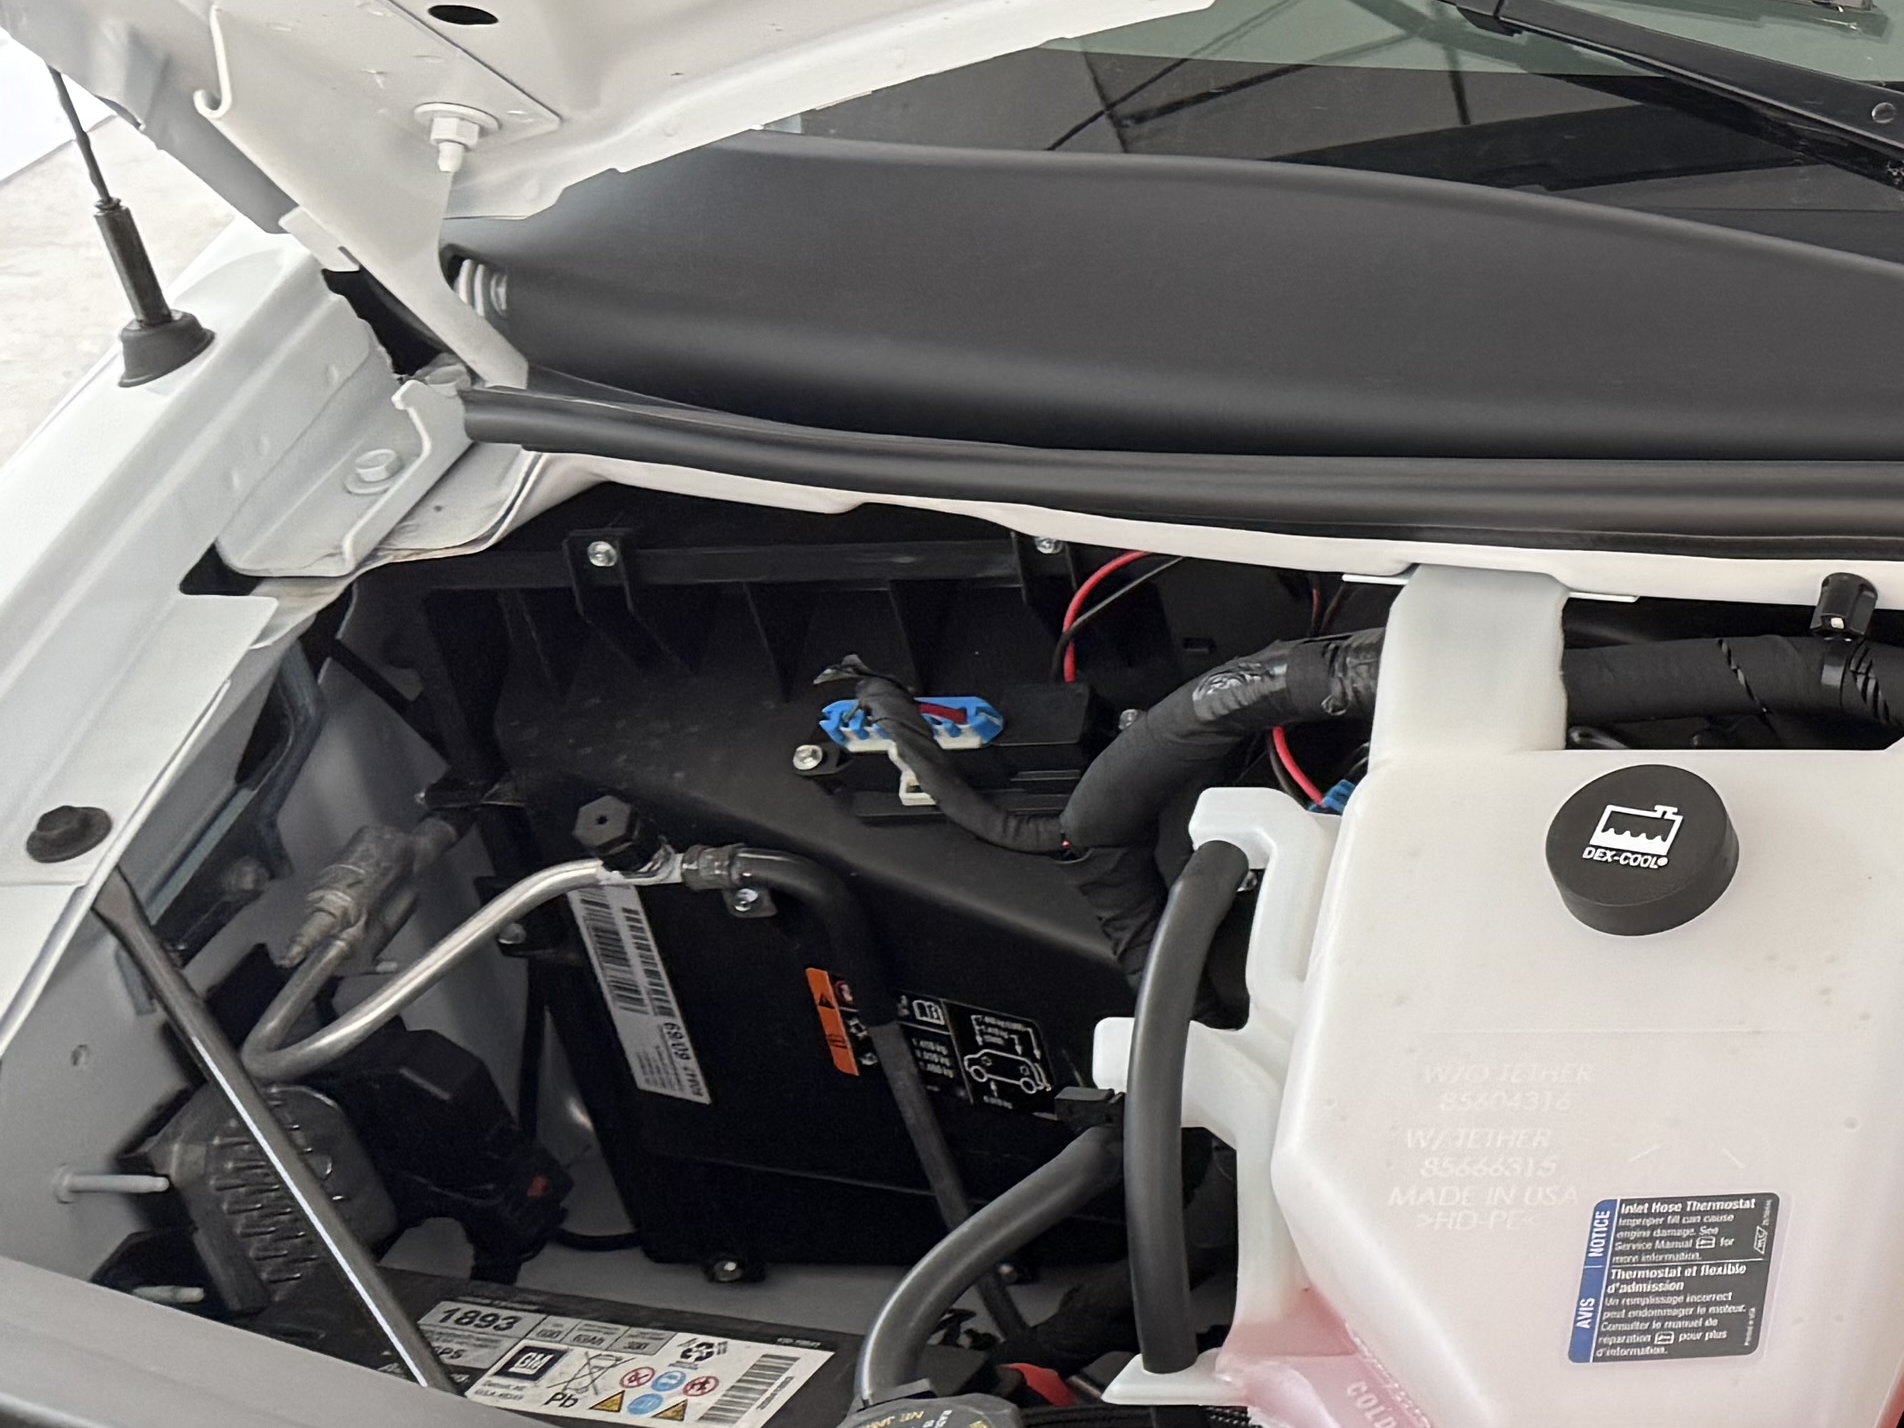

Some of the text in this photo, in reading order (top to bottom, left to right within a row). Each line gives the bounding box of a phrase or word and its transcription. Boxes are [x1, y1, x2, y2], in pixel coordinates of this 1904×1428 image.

[1387, 1184, 1580, 1207] MADE IN USA
[1620, 1198, 1756, 1213] Inlet Hose Thermostat
[1681, 1215, 1701, 1224] can
[1703, 1213, 1735, 1223] cause
[1588, 1210, 1610, 1257] NOTICE
[1616, 1229, 1650, 1240] engine
[1698, 1225, 1719, 1236] See
[1614, 1236, 1735, 1251] Service Manual for
[1612, 1254, 1640, 1264] more
[1610, 1263, 1747, 1280] Thermostat et flexible
[1685, 1291, 1733, 1303] incorrect
[438, 1307, 523, 1332] 1893
[1576, 1297, 1595, 1329] AVIS
[1704, 1328, 1728, 1341] plus
[543, 1391, 579, 1408] Pb
